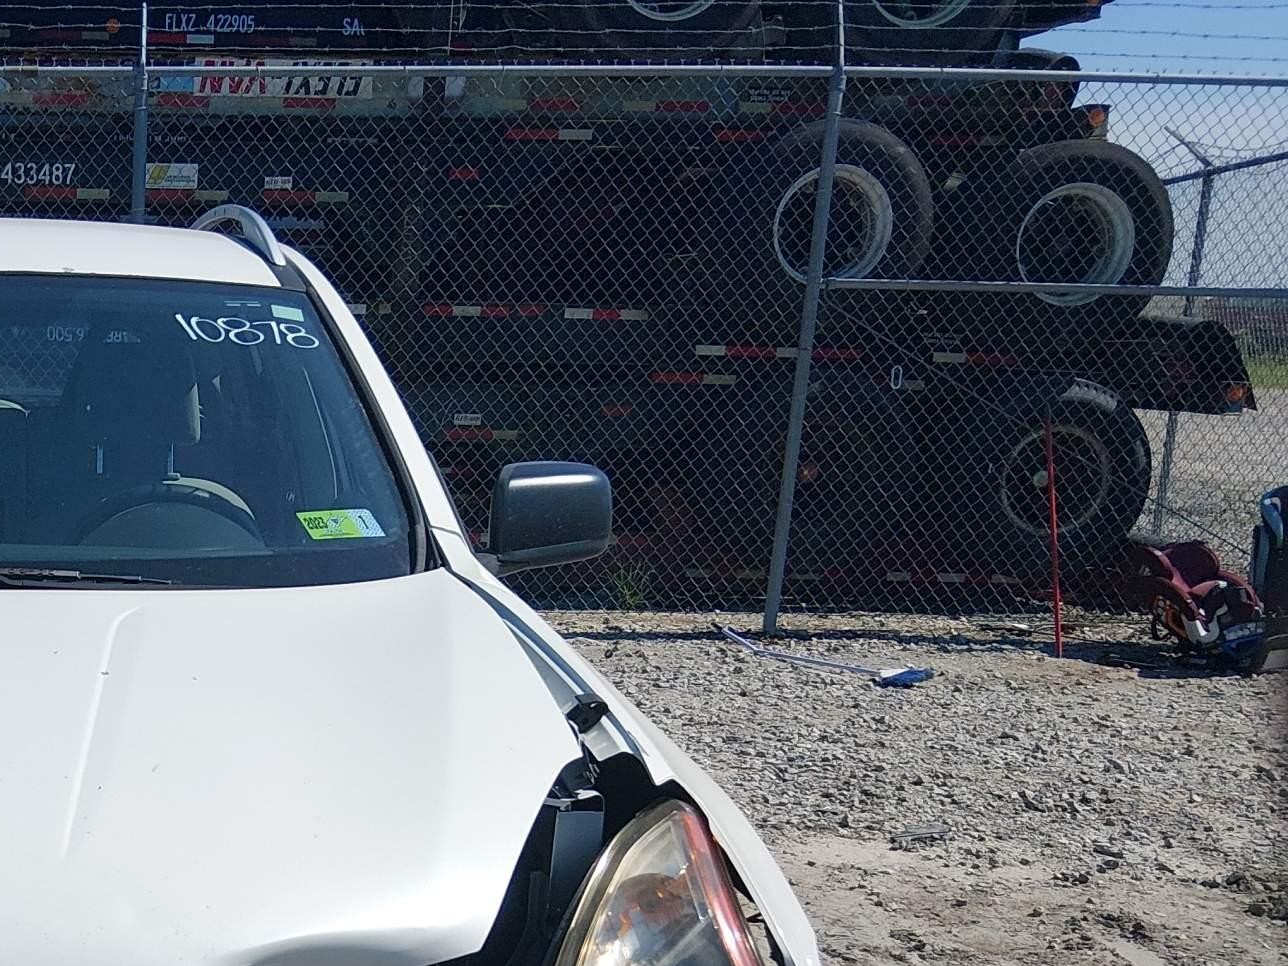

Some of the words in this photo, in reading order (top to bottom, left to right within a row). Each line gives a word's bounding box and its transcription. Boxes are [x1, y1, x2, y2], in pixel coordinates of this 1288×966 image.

[165, 14, 196, 31] FLXZ
[207, 14, 255, 34] 422905
[0, 163, 76, 185] 433487
[175, 313, 320, 349] 10878
